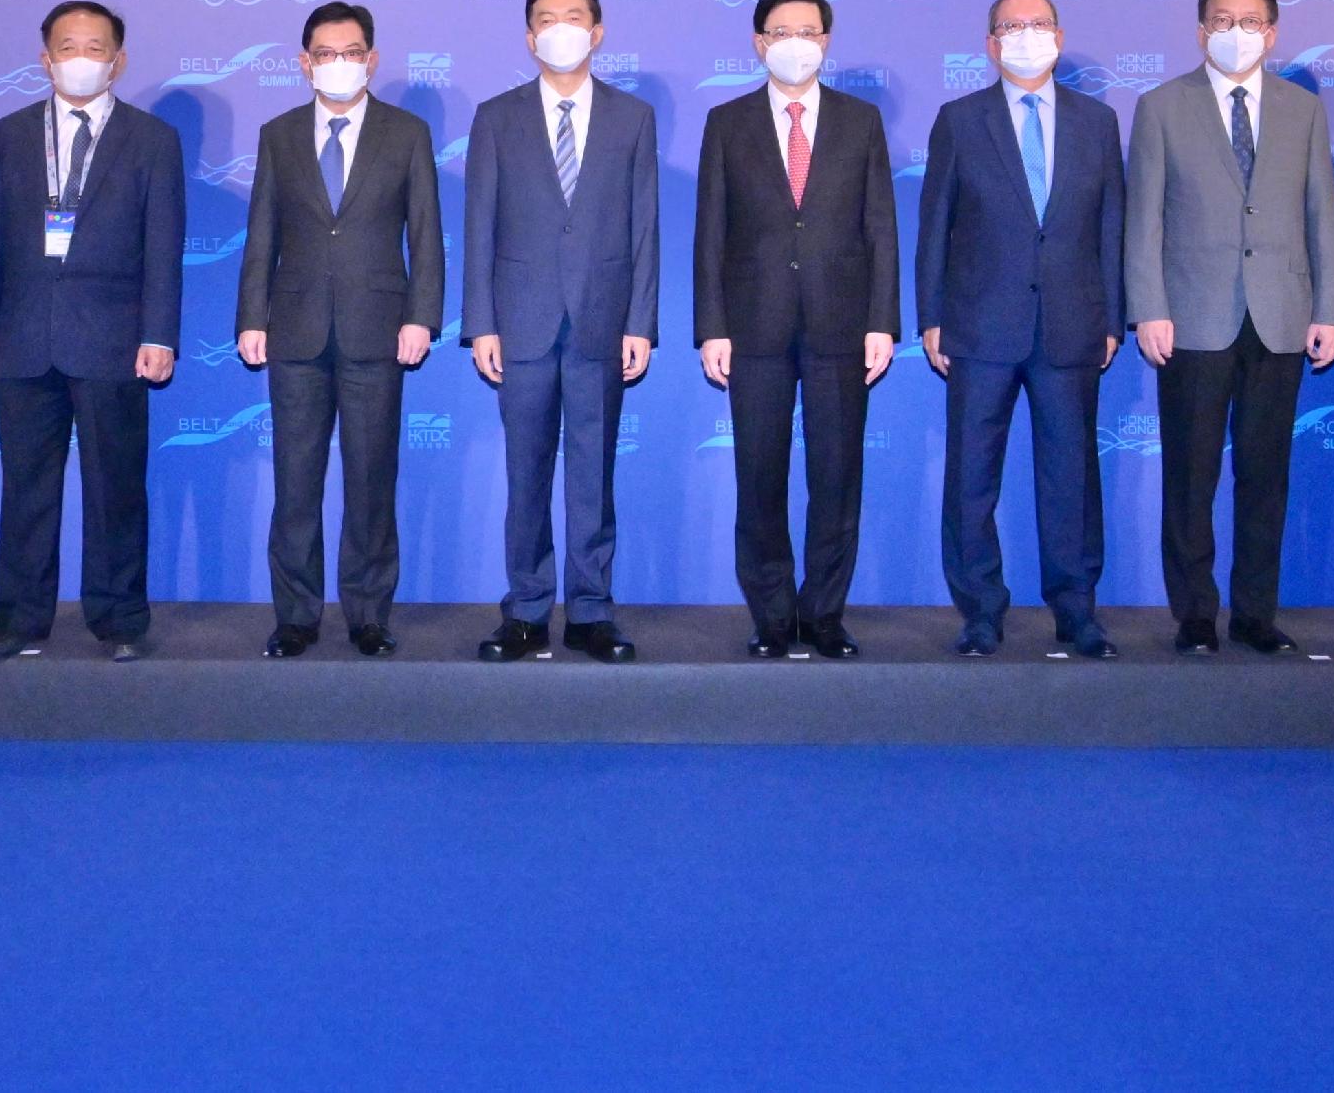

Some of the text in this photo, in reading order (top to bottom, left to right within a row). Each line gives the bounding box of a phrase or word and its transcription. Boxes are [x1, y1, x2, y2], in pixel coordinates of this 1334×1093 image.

[180, 58, 221, 71] BELT
[715, 59, 756, 72] BELT
[259, 75, 300, 86] SUMMIT
[179, 418, 220, 431] BELT
